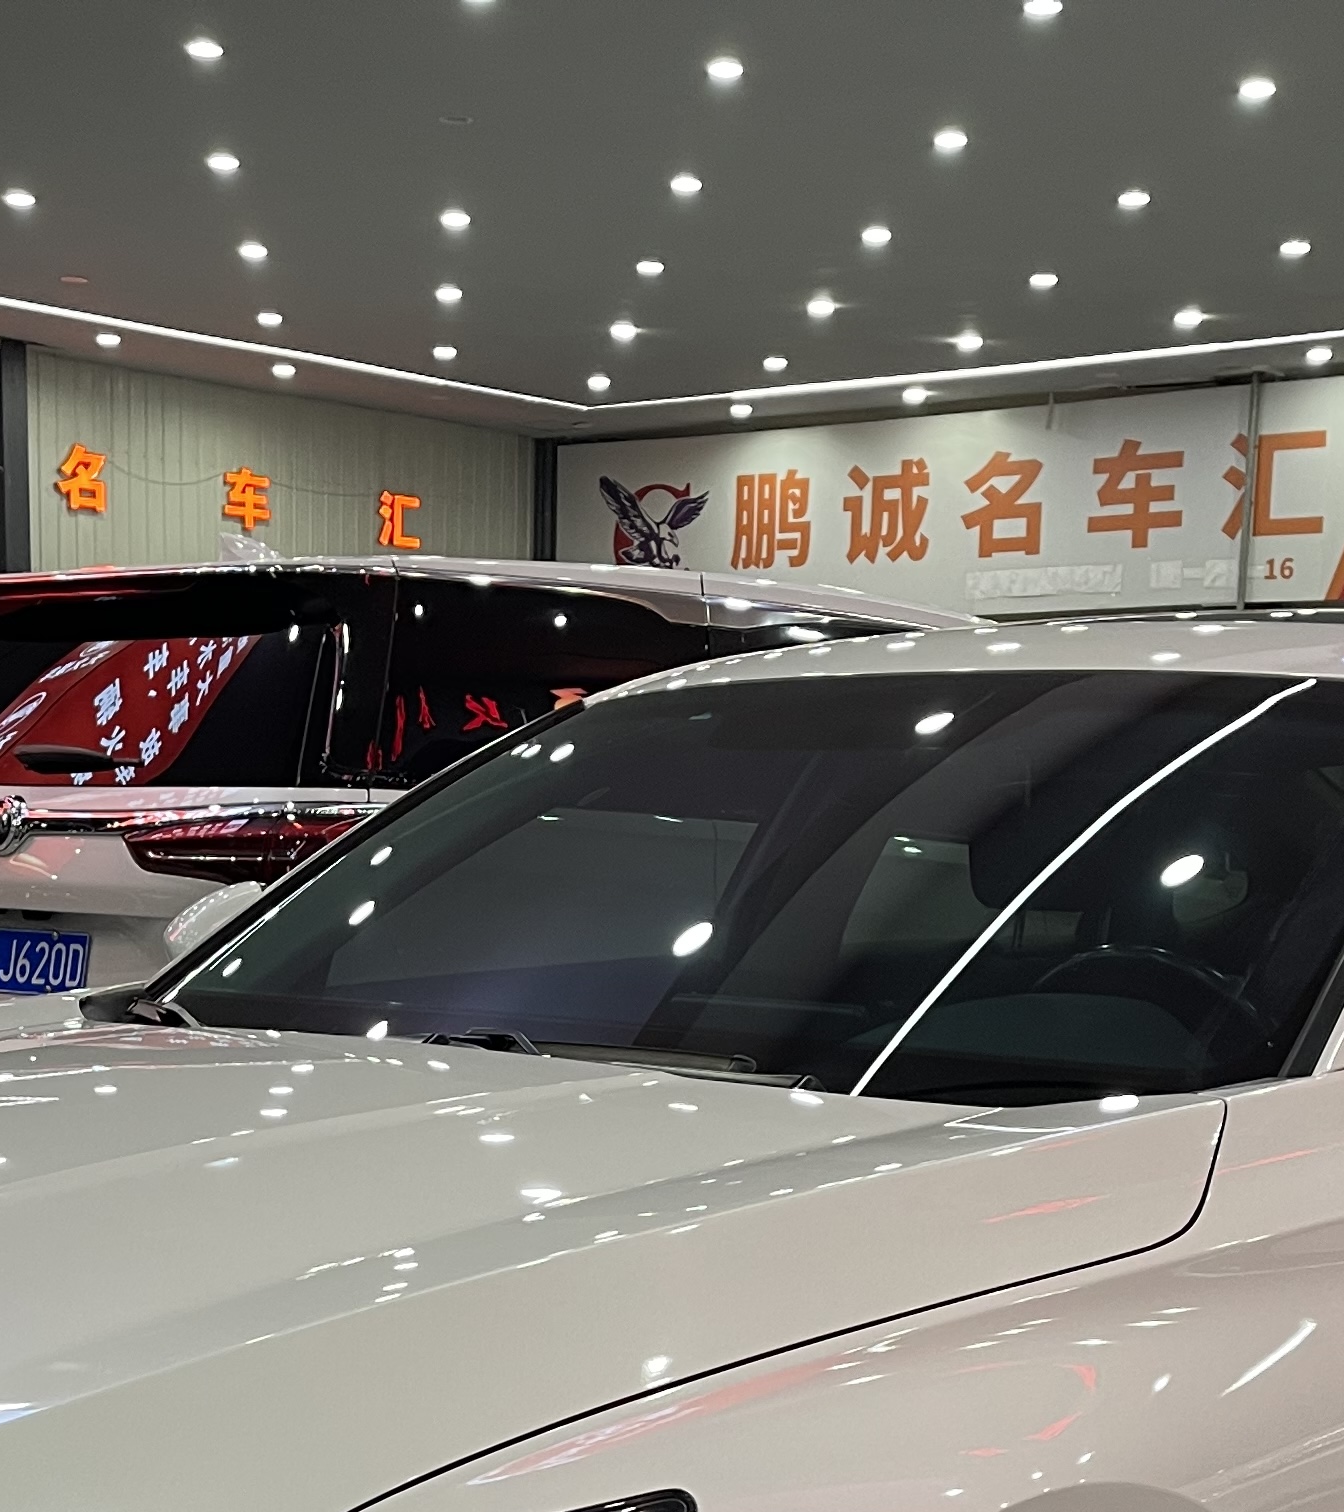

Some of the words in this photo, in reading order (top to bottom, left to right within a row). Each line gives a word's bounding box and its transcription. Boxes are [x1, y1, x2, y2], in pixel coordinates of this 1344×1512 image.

[731, 430, 1327, 570] 鹏诚名车汇
[1264, 557, 1295, 580] 16
